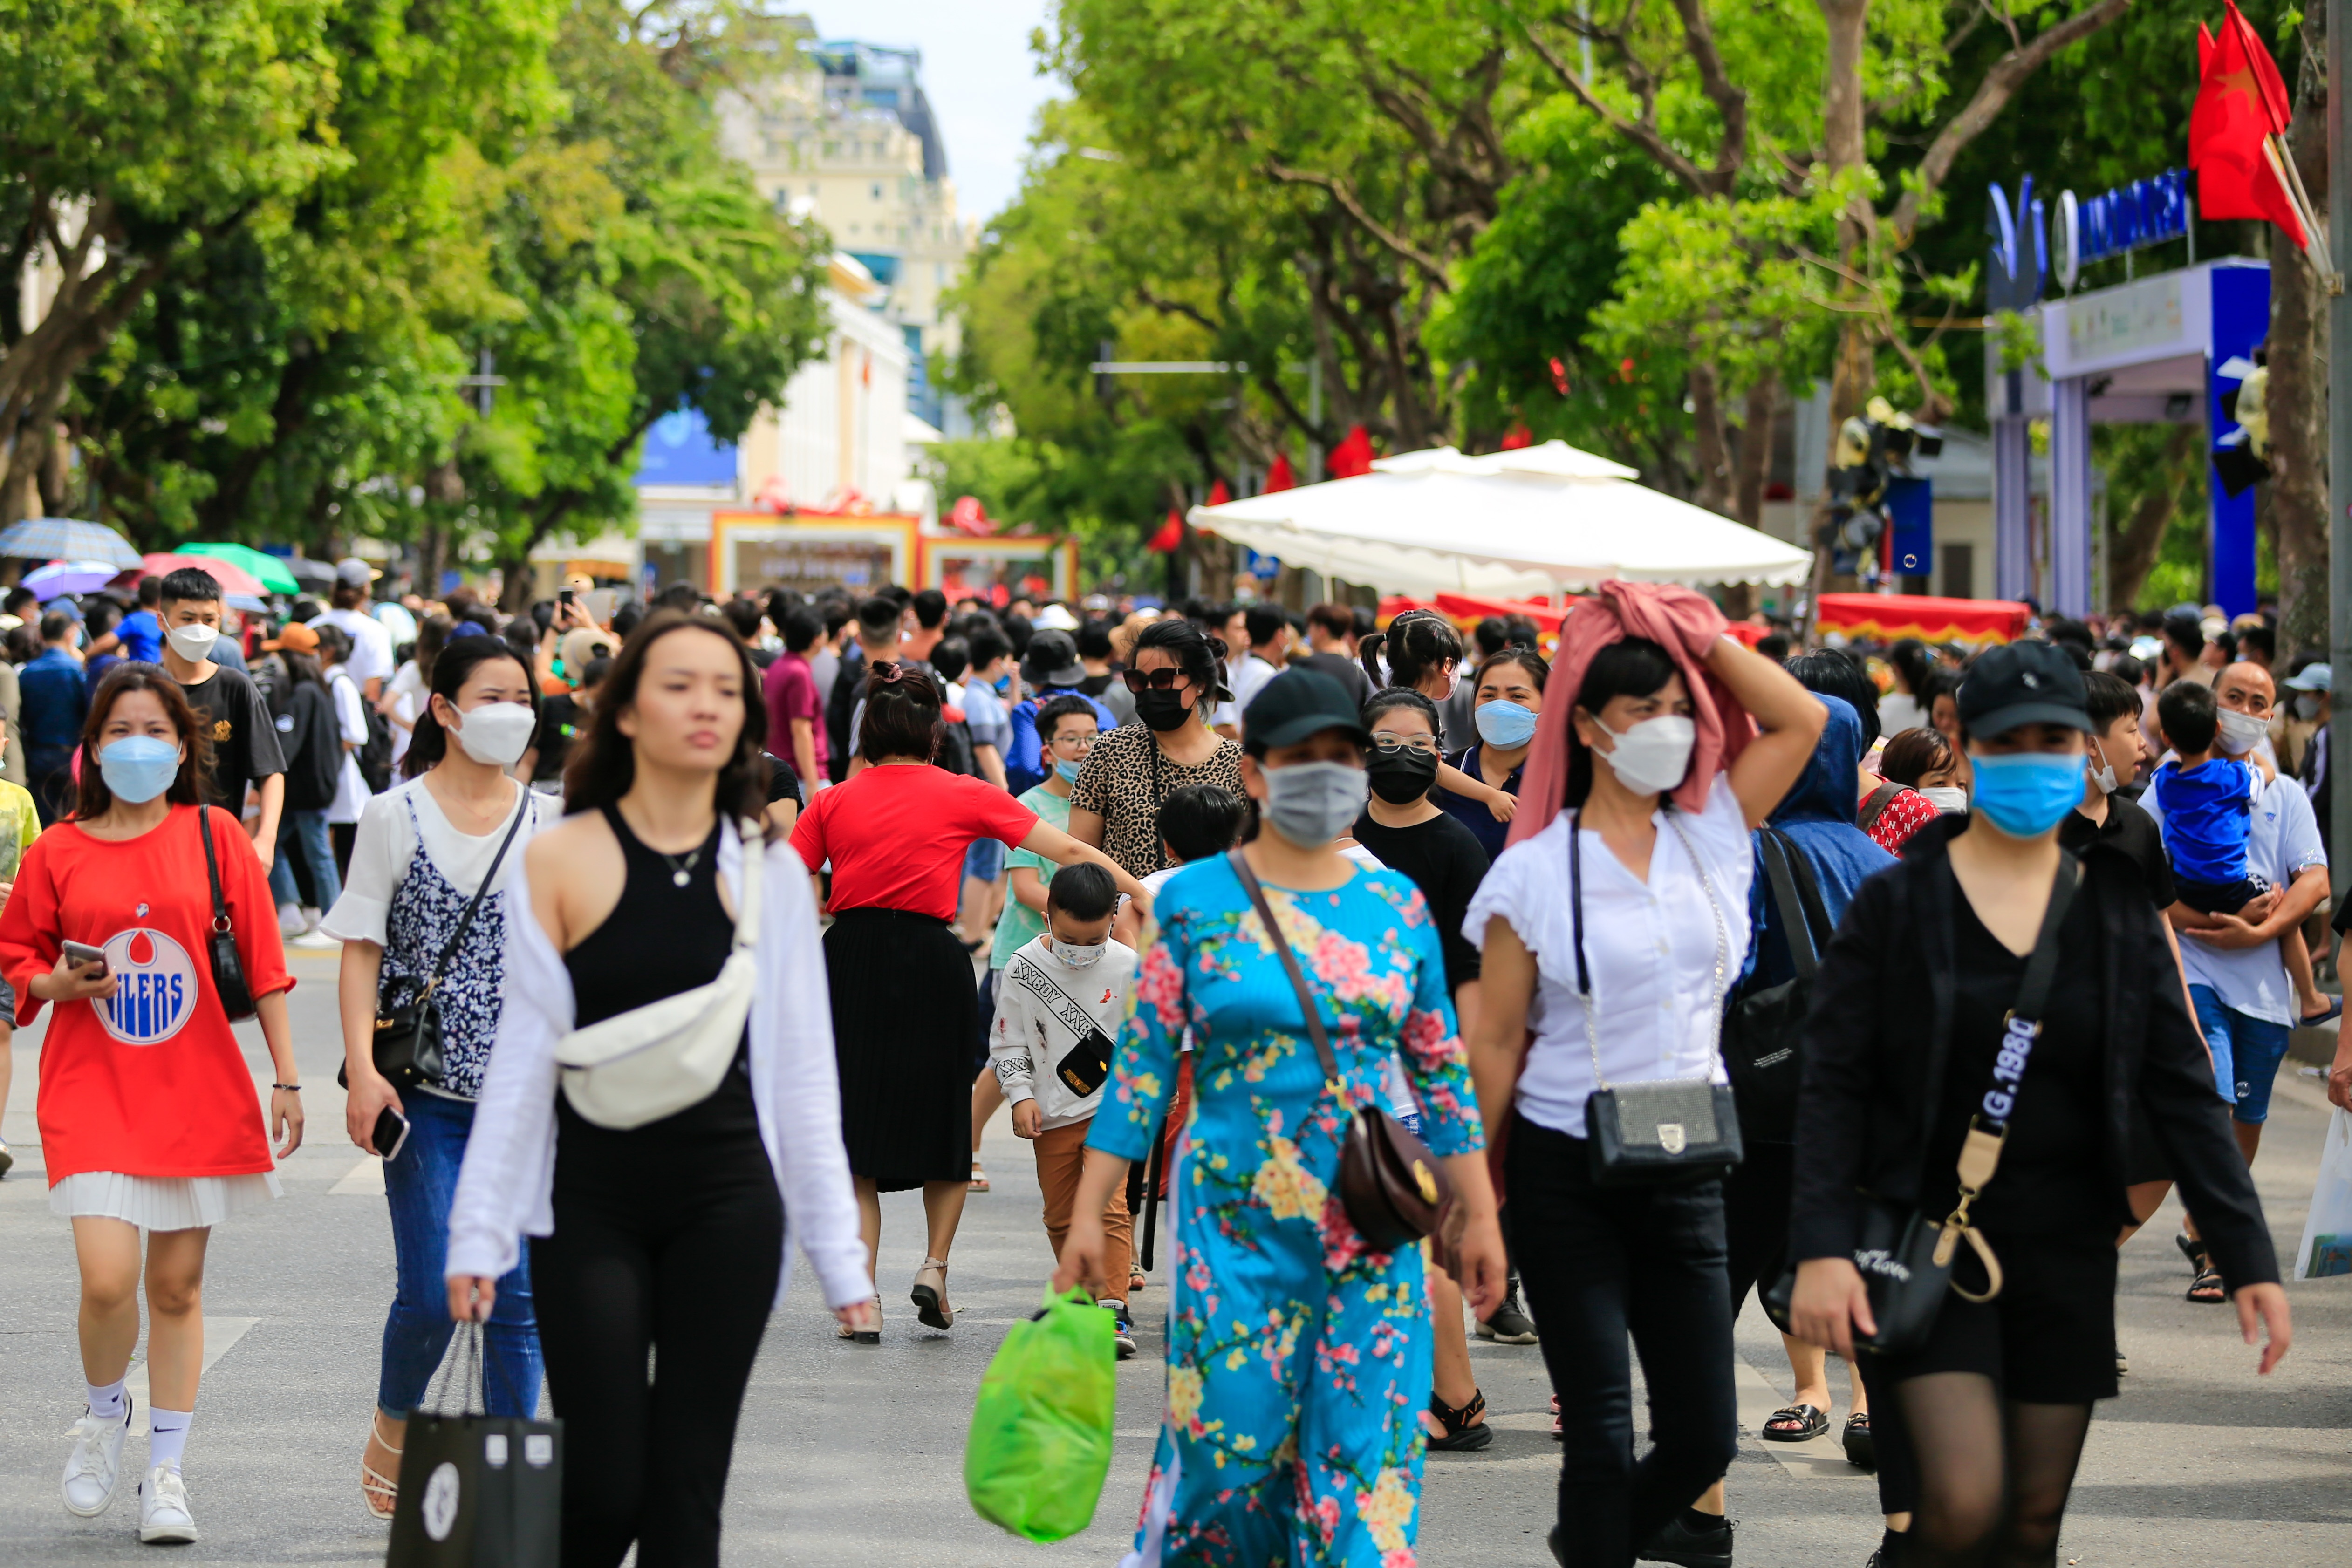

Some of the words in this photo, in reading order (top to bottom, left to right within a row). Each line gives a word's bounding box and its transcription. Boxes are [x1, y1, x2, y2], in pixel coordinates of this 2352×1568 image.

[1014, 959, 1062, 1004] XXBOY
[1059, 1002, 1093, 1036] XXB
[998, 1057, 1027, 1077] XXB
[1982, 1017, 2035, 1126] G.1980
